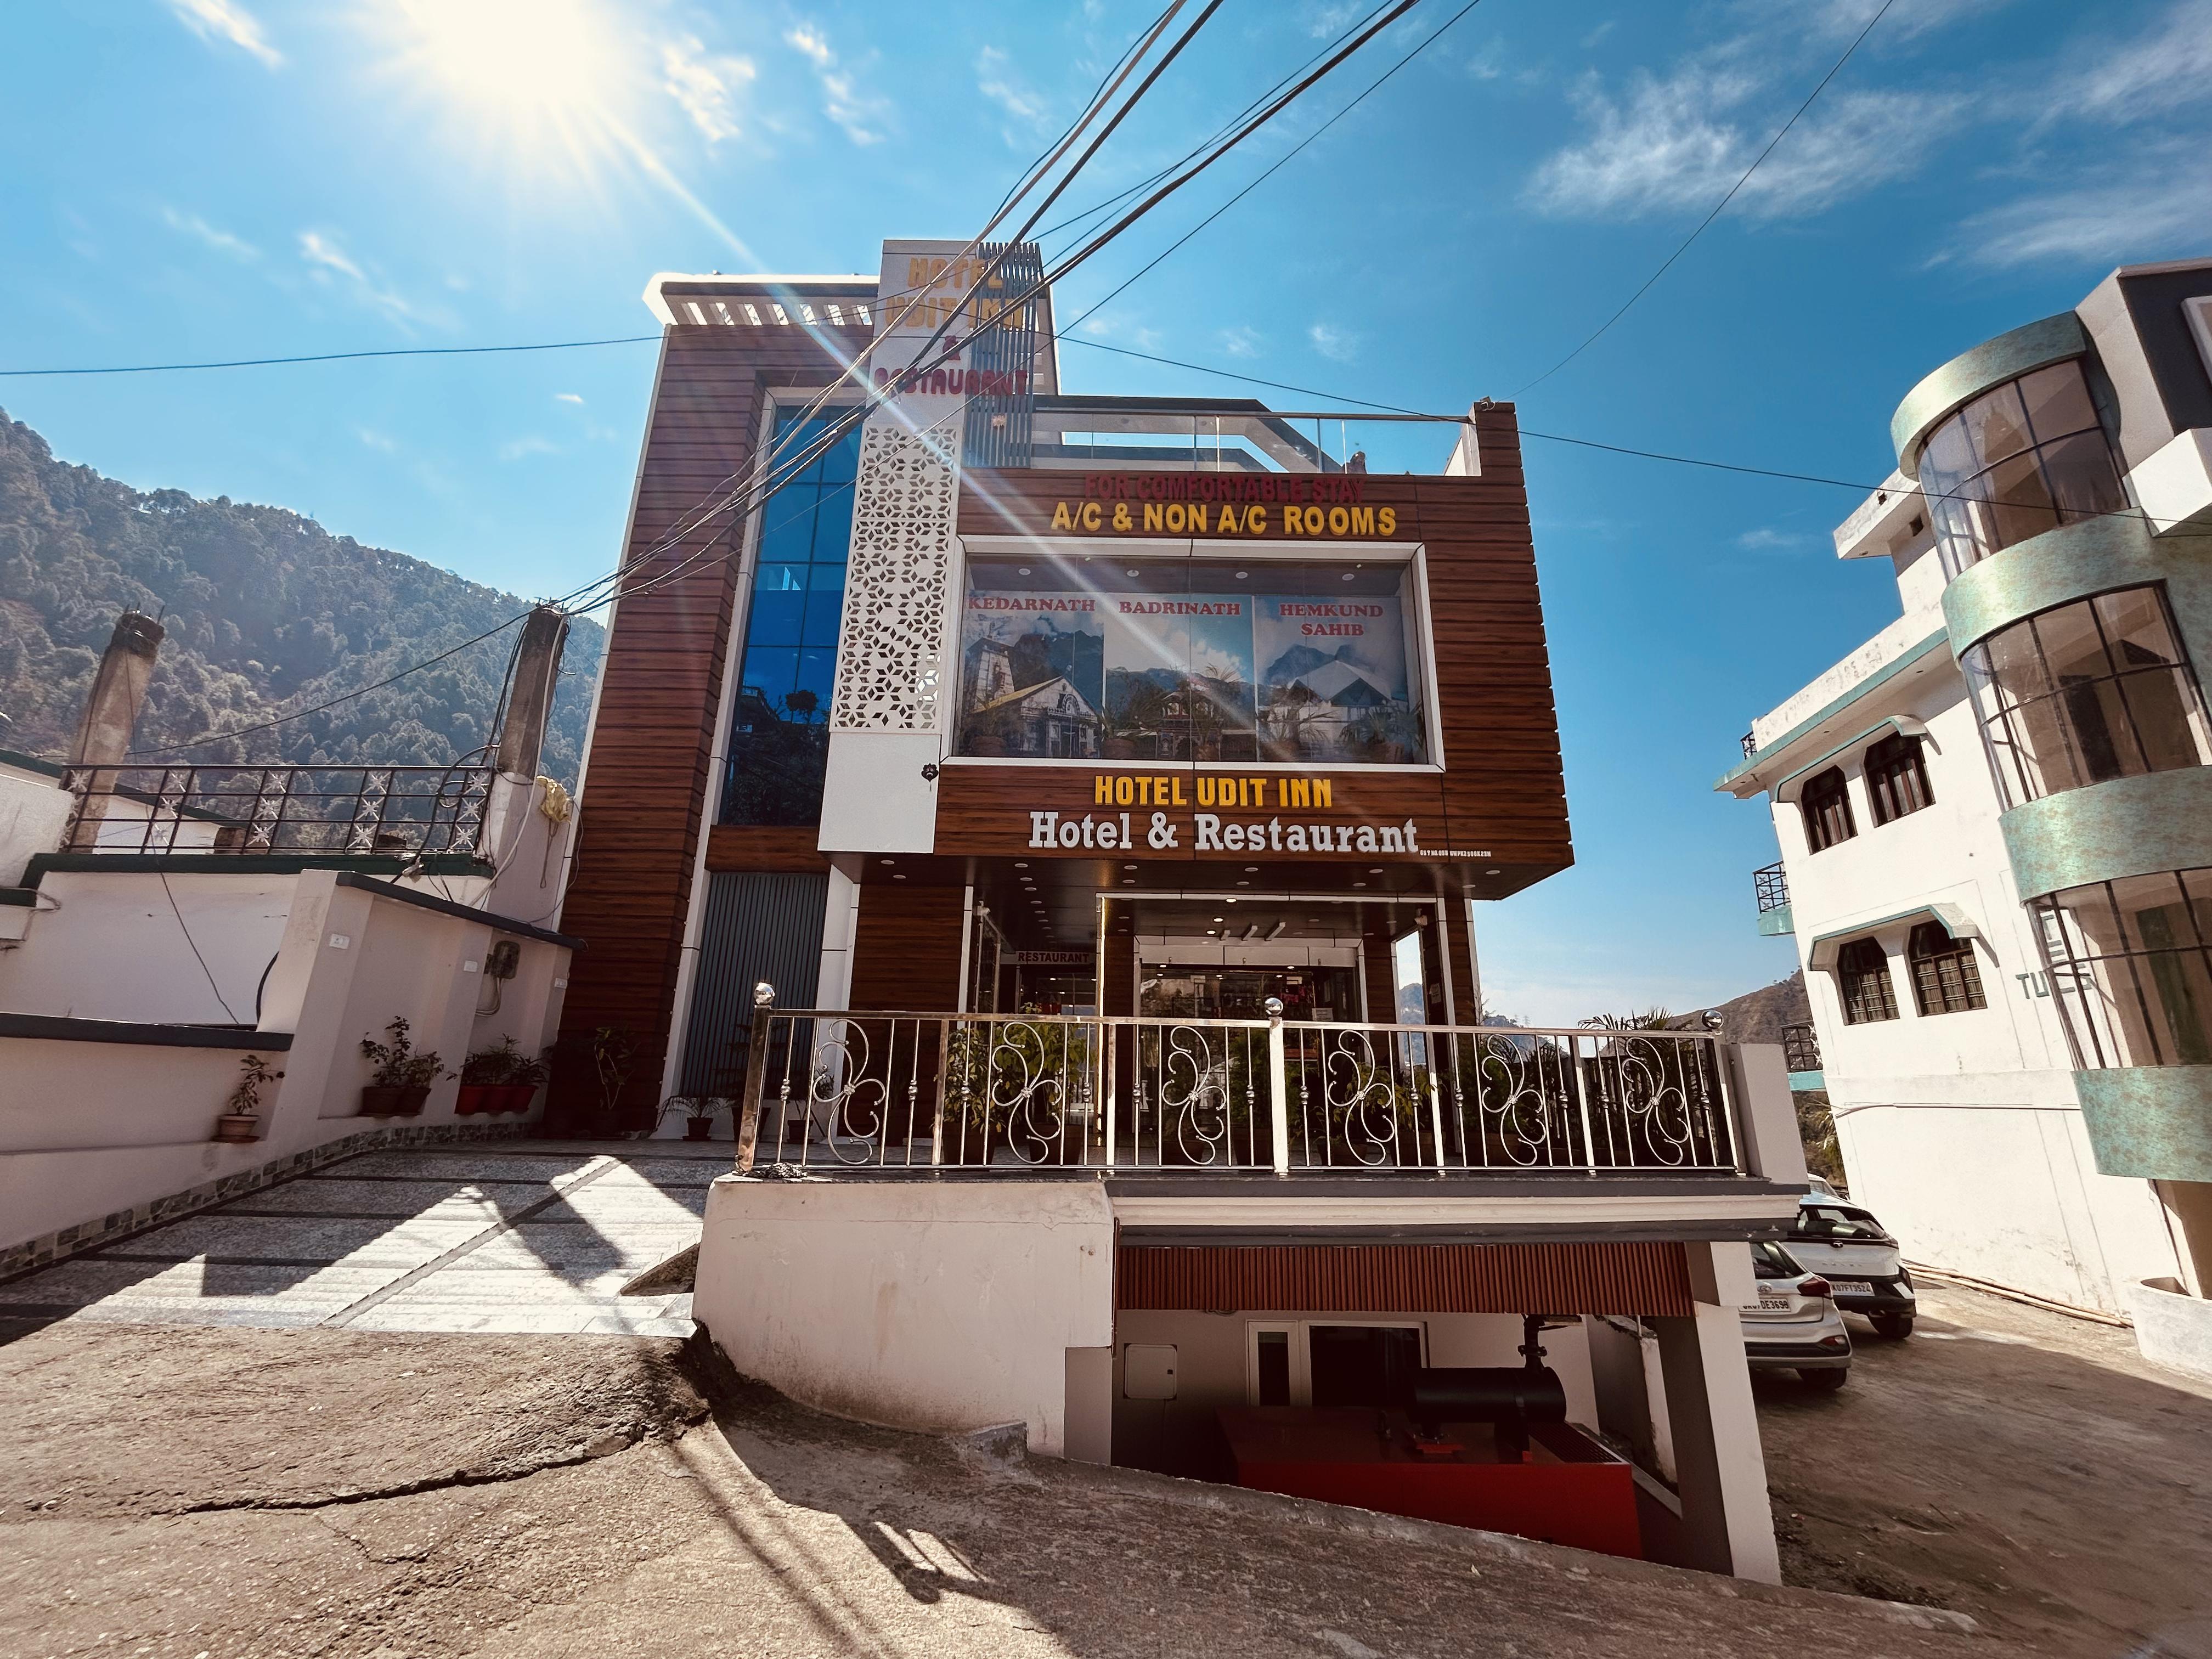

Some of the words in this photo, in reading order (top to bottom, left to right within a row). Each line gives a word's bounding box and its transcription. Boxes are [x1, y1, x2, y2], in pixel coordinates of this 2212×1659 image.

[907, 258, 1003, 289] HOTEL
[885, 297, 958, 328] UDIT
[968, 298, 1024, 329] INN
[1085, 474, 1132, 500] FOR
[1136, 475, 1303, 503] COMFORTABLE
[1312, 477, 1368, 504] STAY
[1051, 501, 1102, 531] A/C
[1113, 503, 1133, 531] &
[1144, 503, 1207, 533] NON
[1217, 504, 1267, 534] A/C
[1284, 505, 1396, 537] ROOMS
[968, 596, 1096, 612] KEDARNATH
[1119, 601, 1242, 616] BADRINATH
[1280, 603, 1384, 618] HEMKUND
[1301, 623, 1364, 636] SAHIB
[1094, 775, 1187, 805] HOTEL
[1197, 777, 1267, 807] UDIT
[1279, 778, 1332, 808] INN
[1029, 811, 1132, 849] Hotel
[1148, 811, 1179, 849] &
[1194, 814, 1419, 853] Restaurant
[1018, 952, 1089, 962] RESTAURANT
